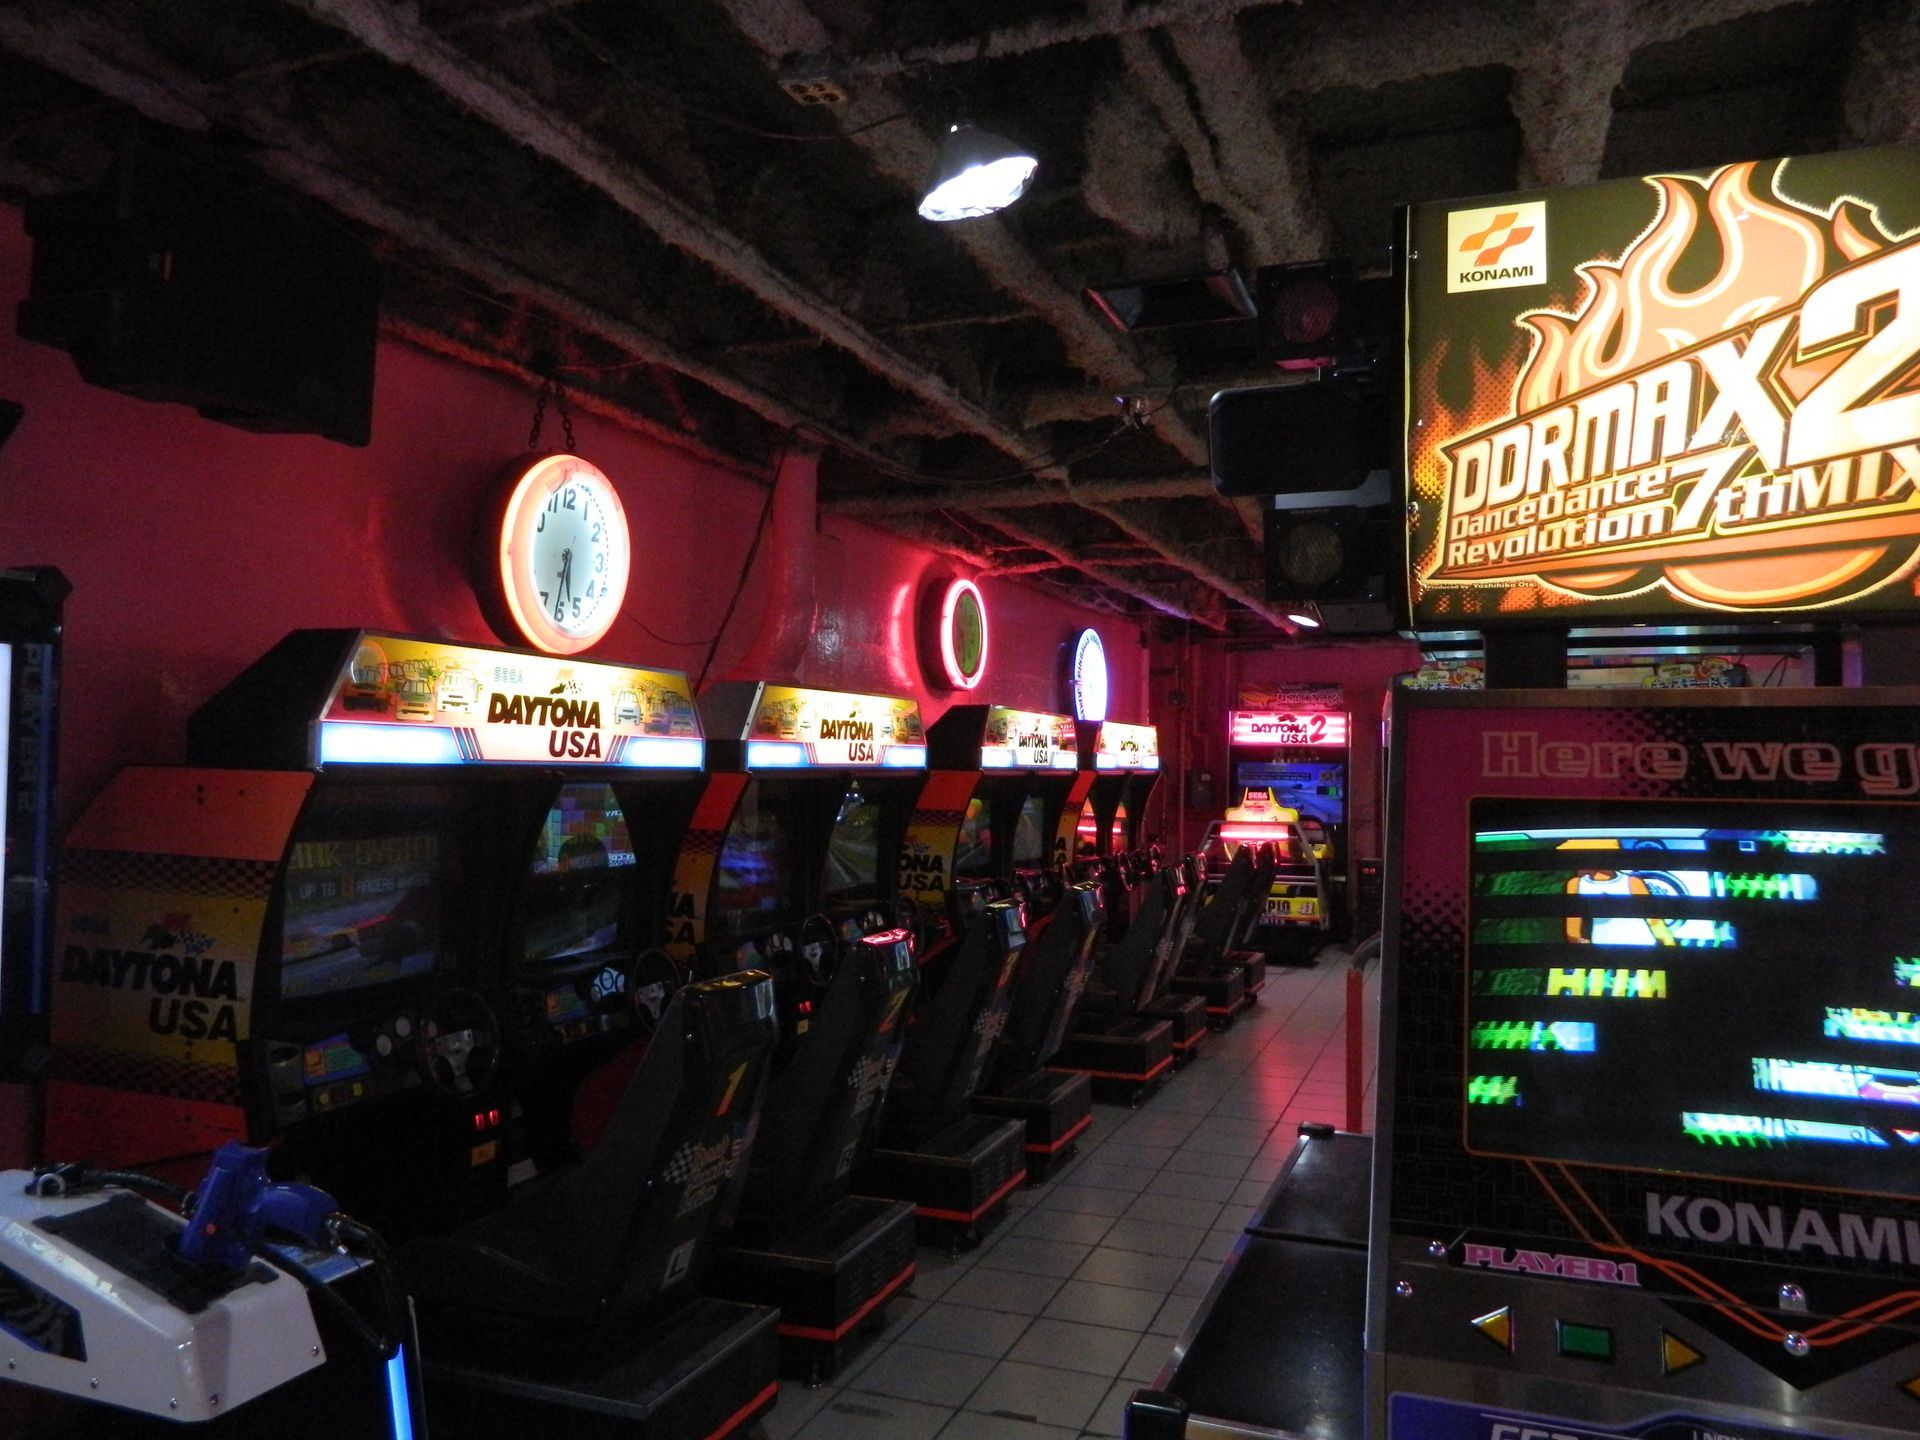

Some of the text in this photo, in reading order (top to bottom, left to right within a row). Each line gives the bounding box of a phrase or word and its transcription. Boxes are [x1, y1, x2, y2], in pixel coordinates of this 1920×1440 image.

[1459, 264, 1534, 284] KONAMI
[563, 487, 577, 511] 12
[591, 522, 600, 543] 2
[1448, 506, 1664, 567] Revolution
[594, 553, 604, 574] 3
[585, 579, 595, 601] 4
[554, 601, 565, 623] 6
[572, 597, 581, 619] 5
[487, 692, 601, 729] DAYTONA
[820, 718, 874, 741] DAYTONA
[1251, 723, 1308, 733] DAYTONA
[1281, 714, 1328, 744] USA 2
[549, 729, 601, 758] USA
[1018, 732, 1048, 749] DAYTONA
[848, 742, 874, 762] USA
[1033, 749, 1048, 764] USA
[1481, 730, 1920, 796] Here we g
[62, 943, 238, 1000] DAYTONA
[150, 996, 238, 1044] USA
[1644, 1191, 1920, 1266] KONAMI
